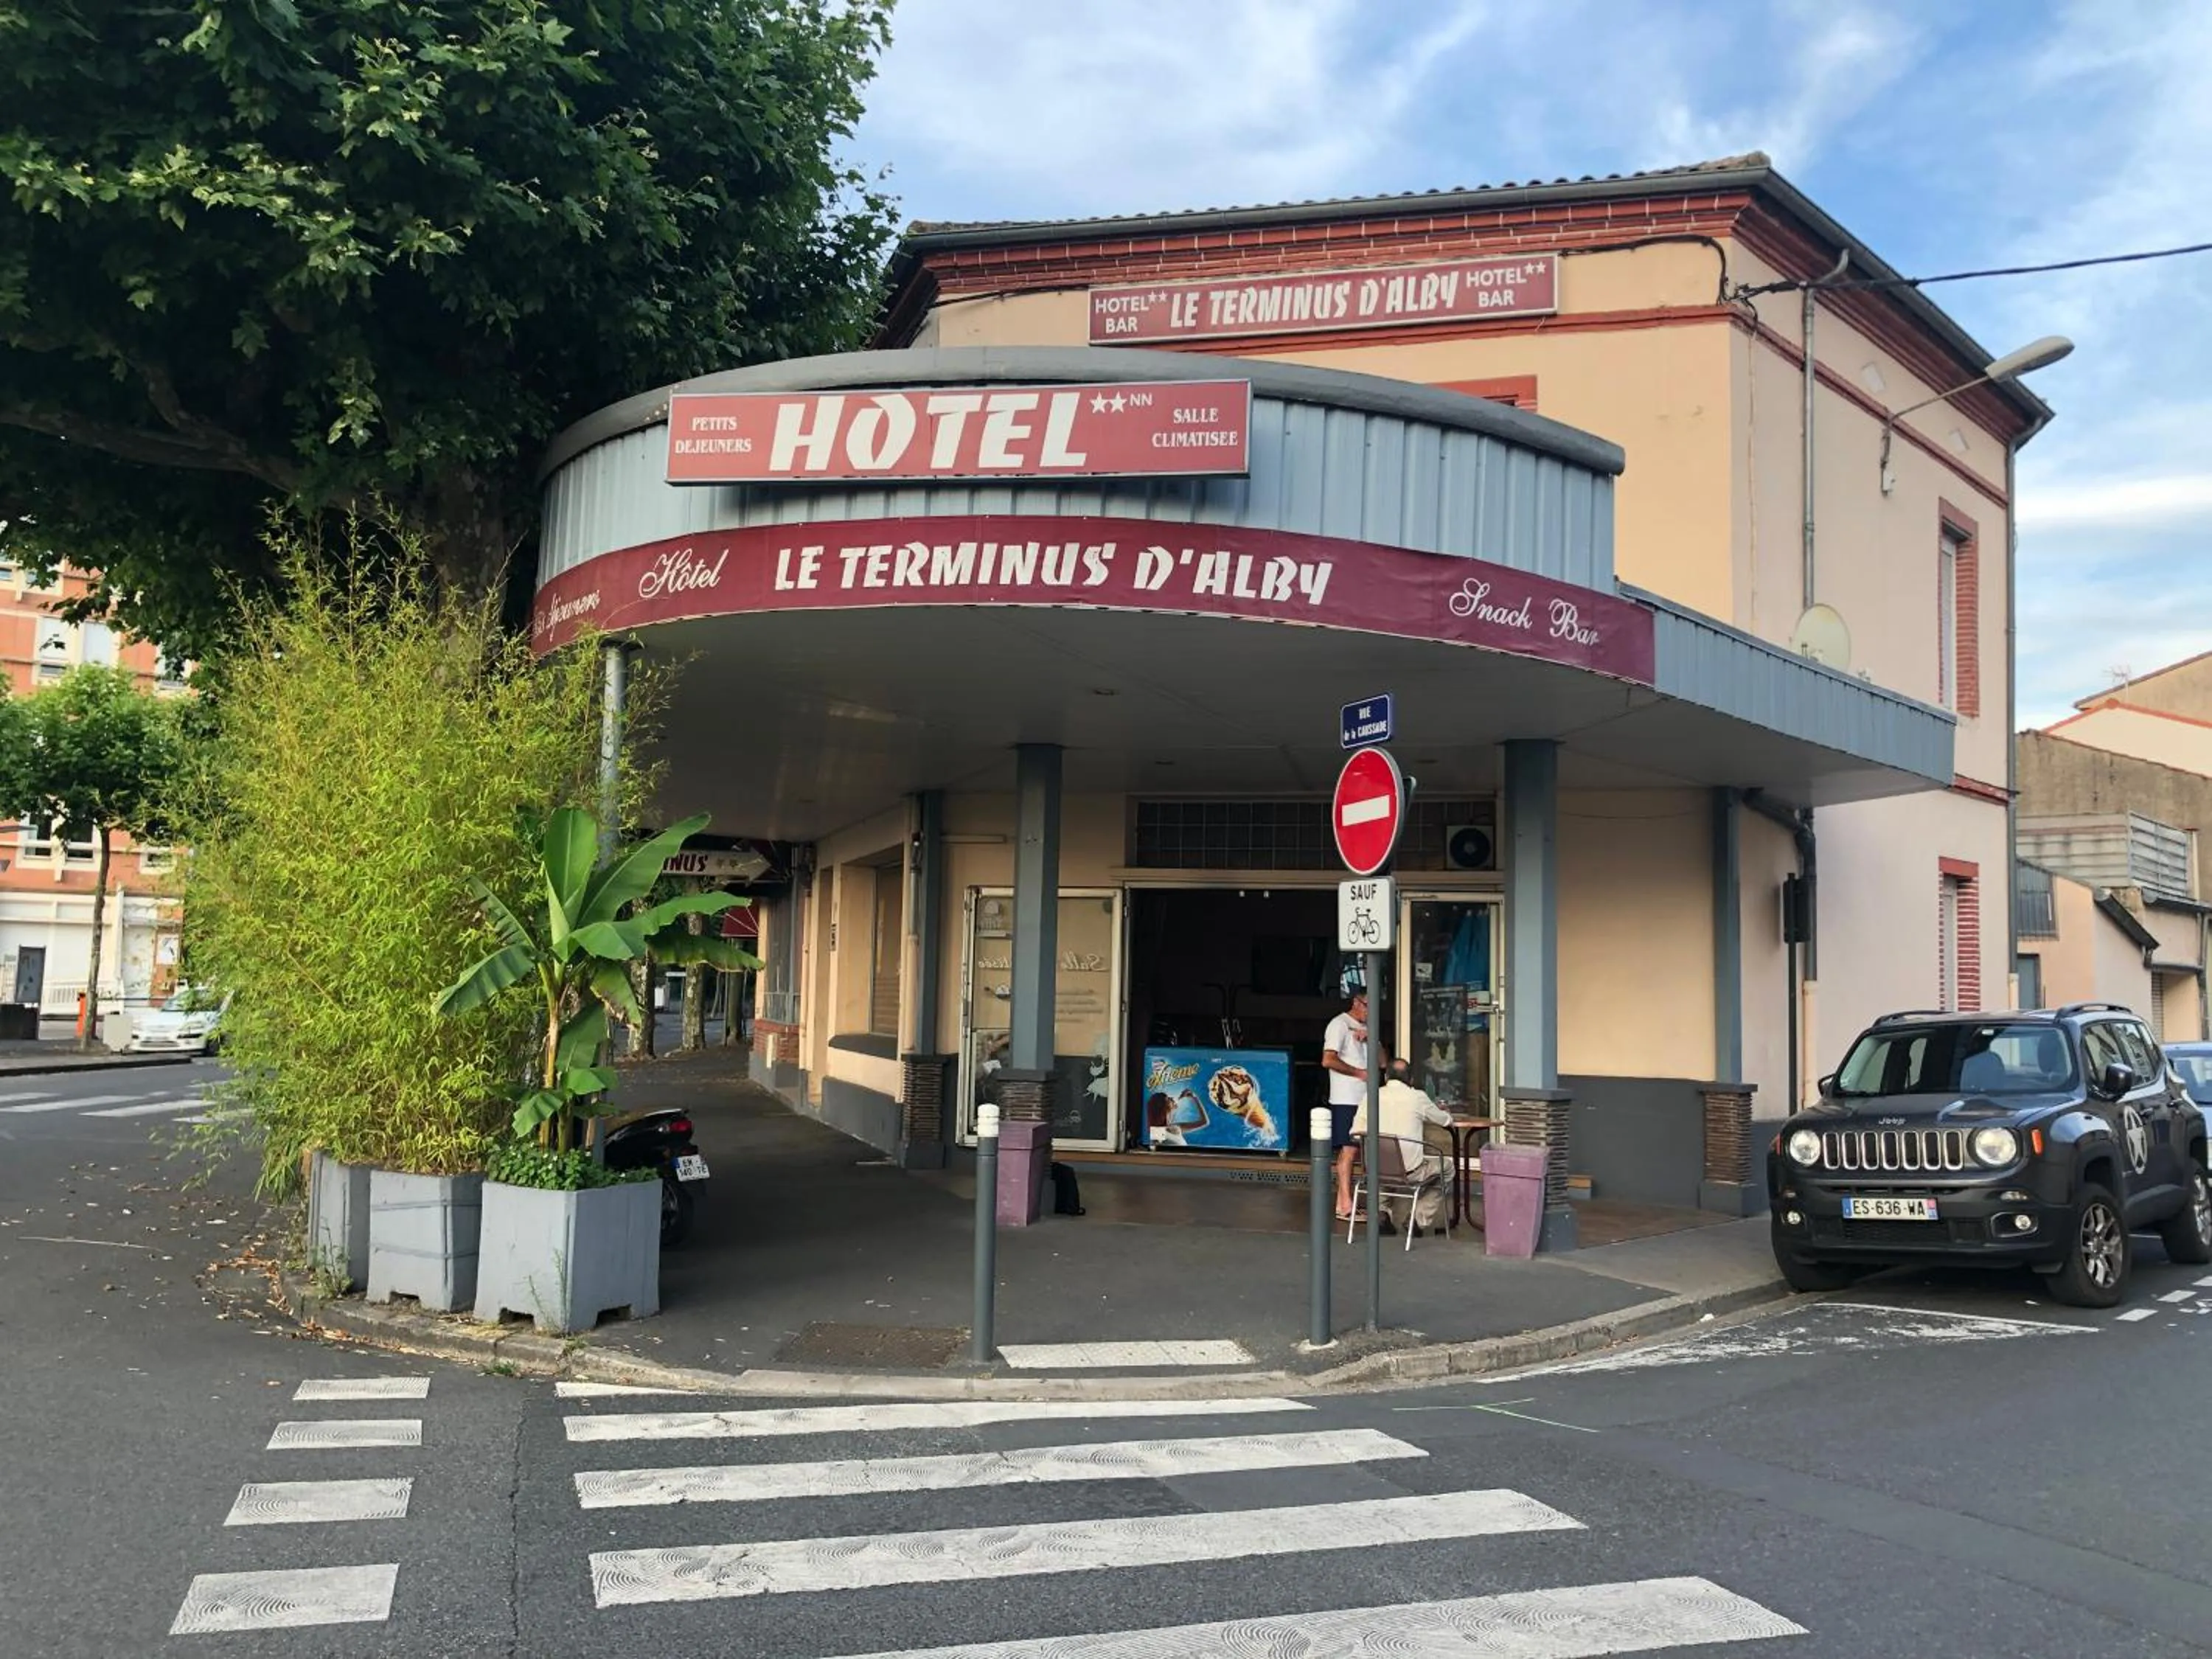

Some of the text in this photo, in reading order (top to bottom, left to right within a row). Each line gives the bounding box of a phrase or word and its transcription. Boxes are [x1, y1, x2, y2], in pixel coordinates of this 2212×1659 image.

[1466, 267, 1527, 288] HOTEL
[1095, 296, 1150, 313] HOTEL
[1170, 271, 1458, 327] LE TERMINUS D'ALBY
[1478, 290, 1514, 307] BAR
[1105, 316, 1138, 333] BAR
[1130, 393, 1152, 406] NN
[692, 416, 737, 431] PETITS
[1173, 408, 1219, 424] SALLE
[768, 392, 1087, 471] HOTEL
[1152, 431, 1238, 448] CLIMATISEE
[675, 438, 752, 454] DEJEUNERS
[638, 548, 729, 598] Hôtel
[774, 540, 1333, 605] LE TERMINUS D'ALBY
[1449, 577, 1599, 646] Snack Bar
[1359, 706, 1371, 720] RUE
[663, 854, 708, 872] INUS
[1350, 884, 1377, 901] SAUF
[1878, 1117, 1906, 1125] Jeep
